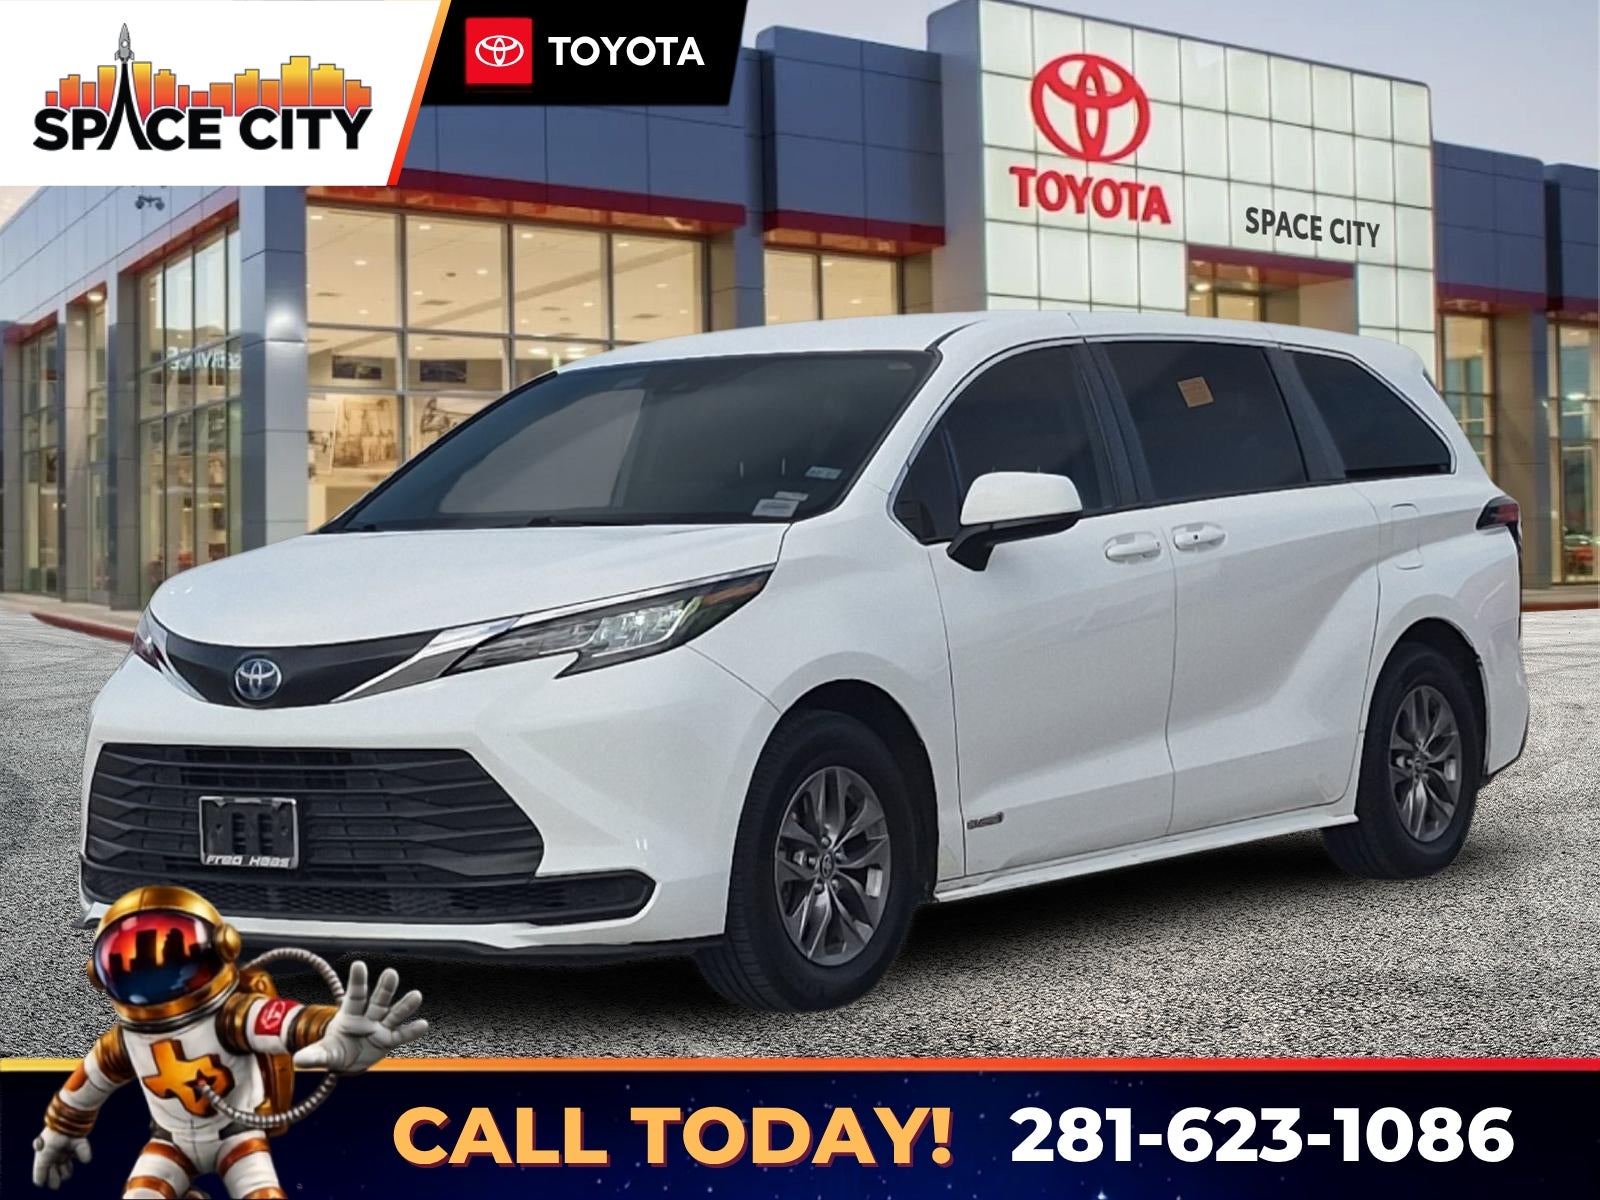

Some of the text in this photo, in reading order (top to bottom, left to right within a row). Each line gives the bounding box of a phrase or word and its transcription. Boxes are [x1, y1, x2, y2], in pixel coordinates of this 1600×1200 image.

[1009, 166, 1171, 224] TOYOTA
[1245, 206, 1381, 248] SPACE CITY
